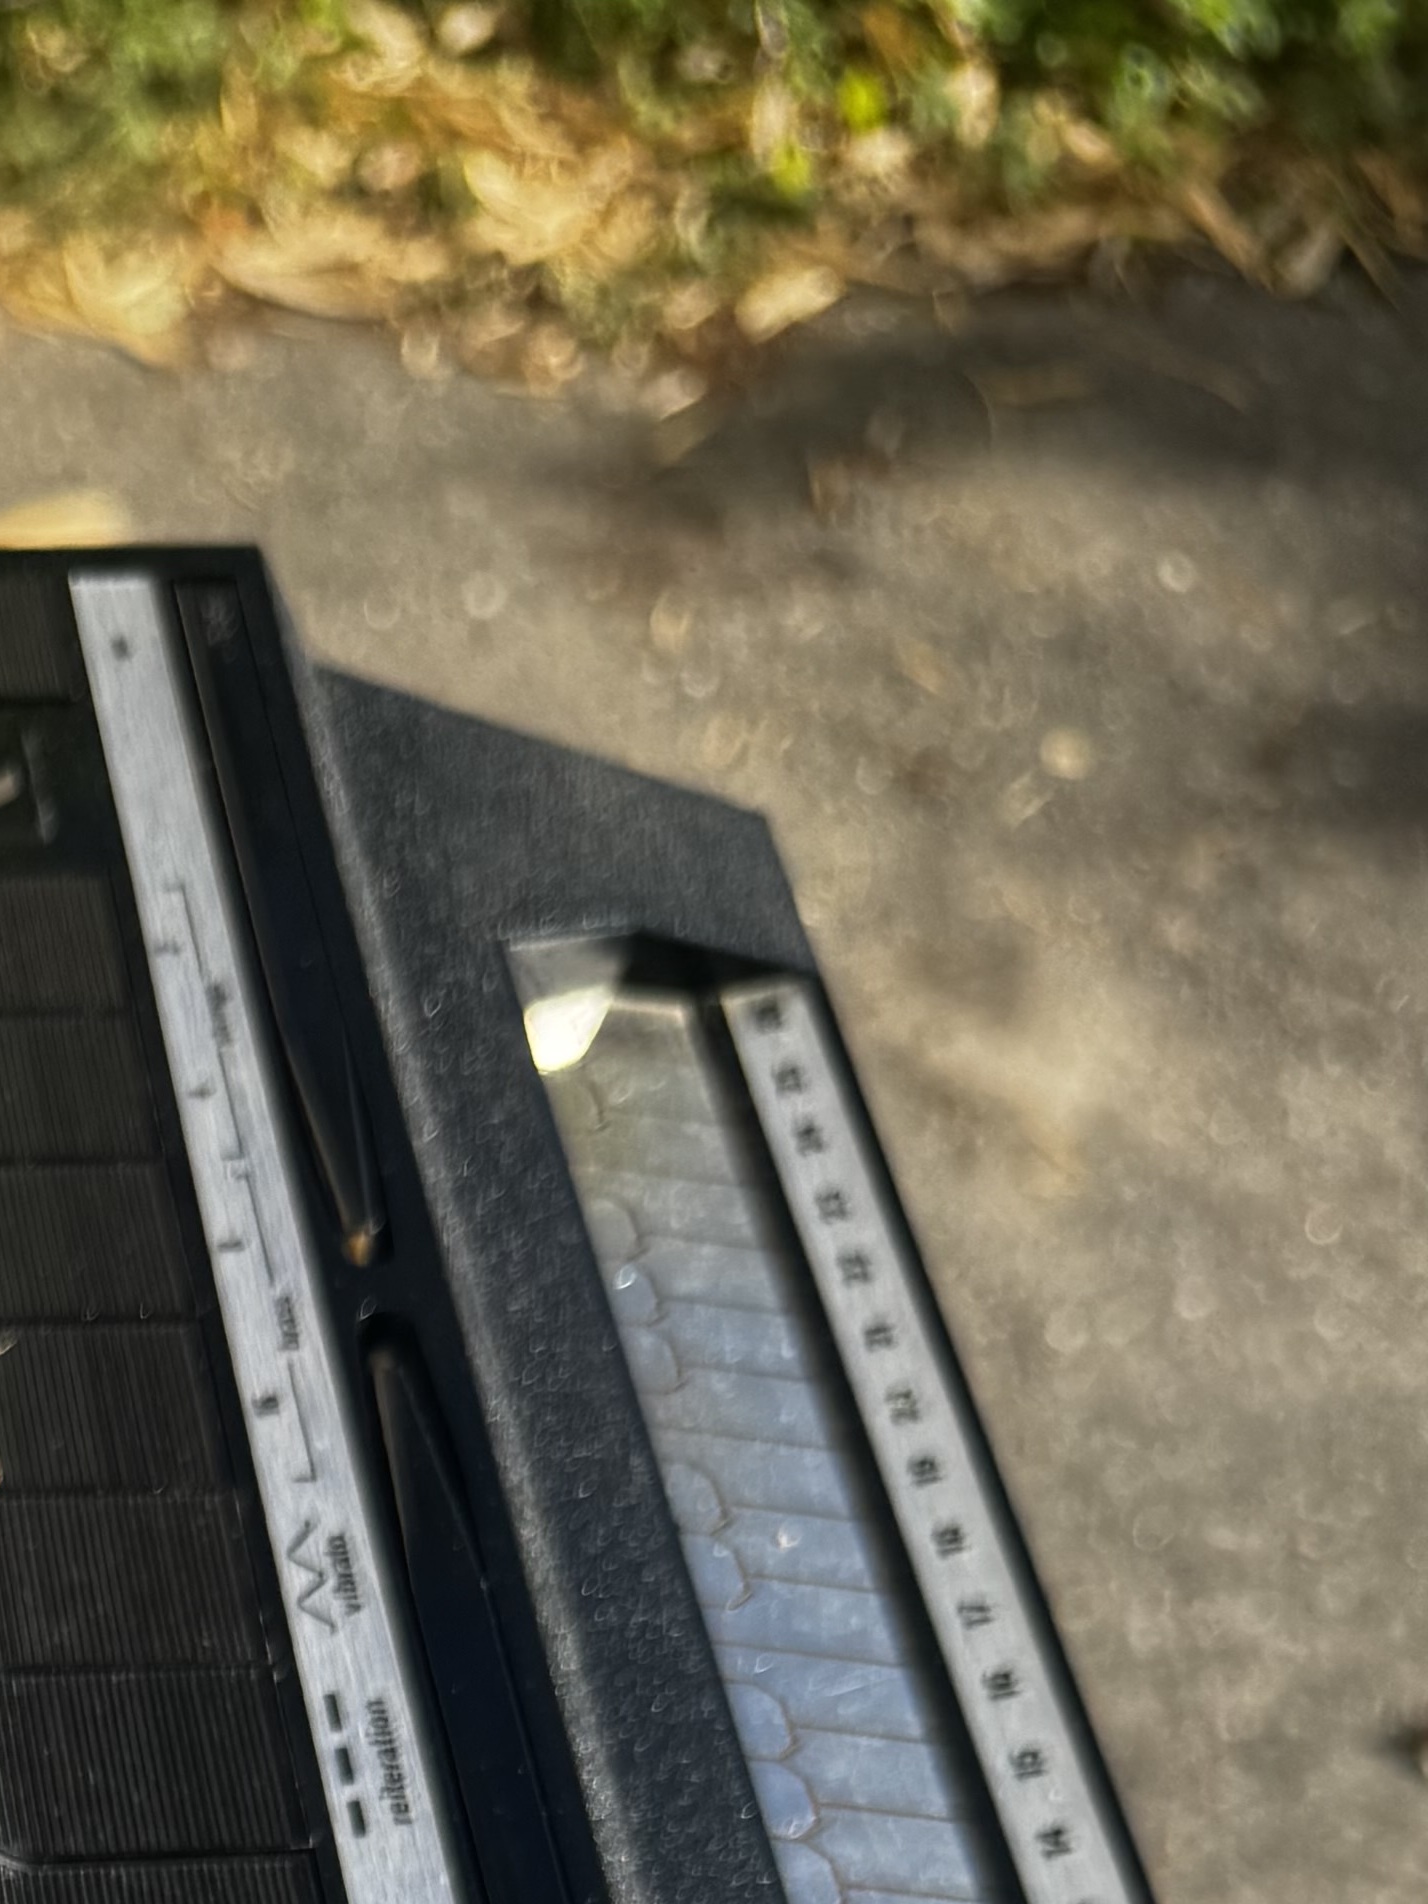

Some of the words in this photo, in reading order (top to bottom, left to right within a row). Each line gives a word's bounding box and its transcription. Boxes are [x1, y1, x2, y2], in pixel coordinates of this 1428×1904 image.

[323, 1533, 363, 1617] vibrato
[956, 1597, 995, 1629] 17
[981, 1663, 1021, 1702] 16
[365, 1698, 413, 1827] reiteration
[1008, 1744, 1046, 1781] 15
[1035, 1822, 1074, 1861] 14
